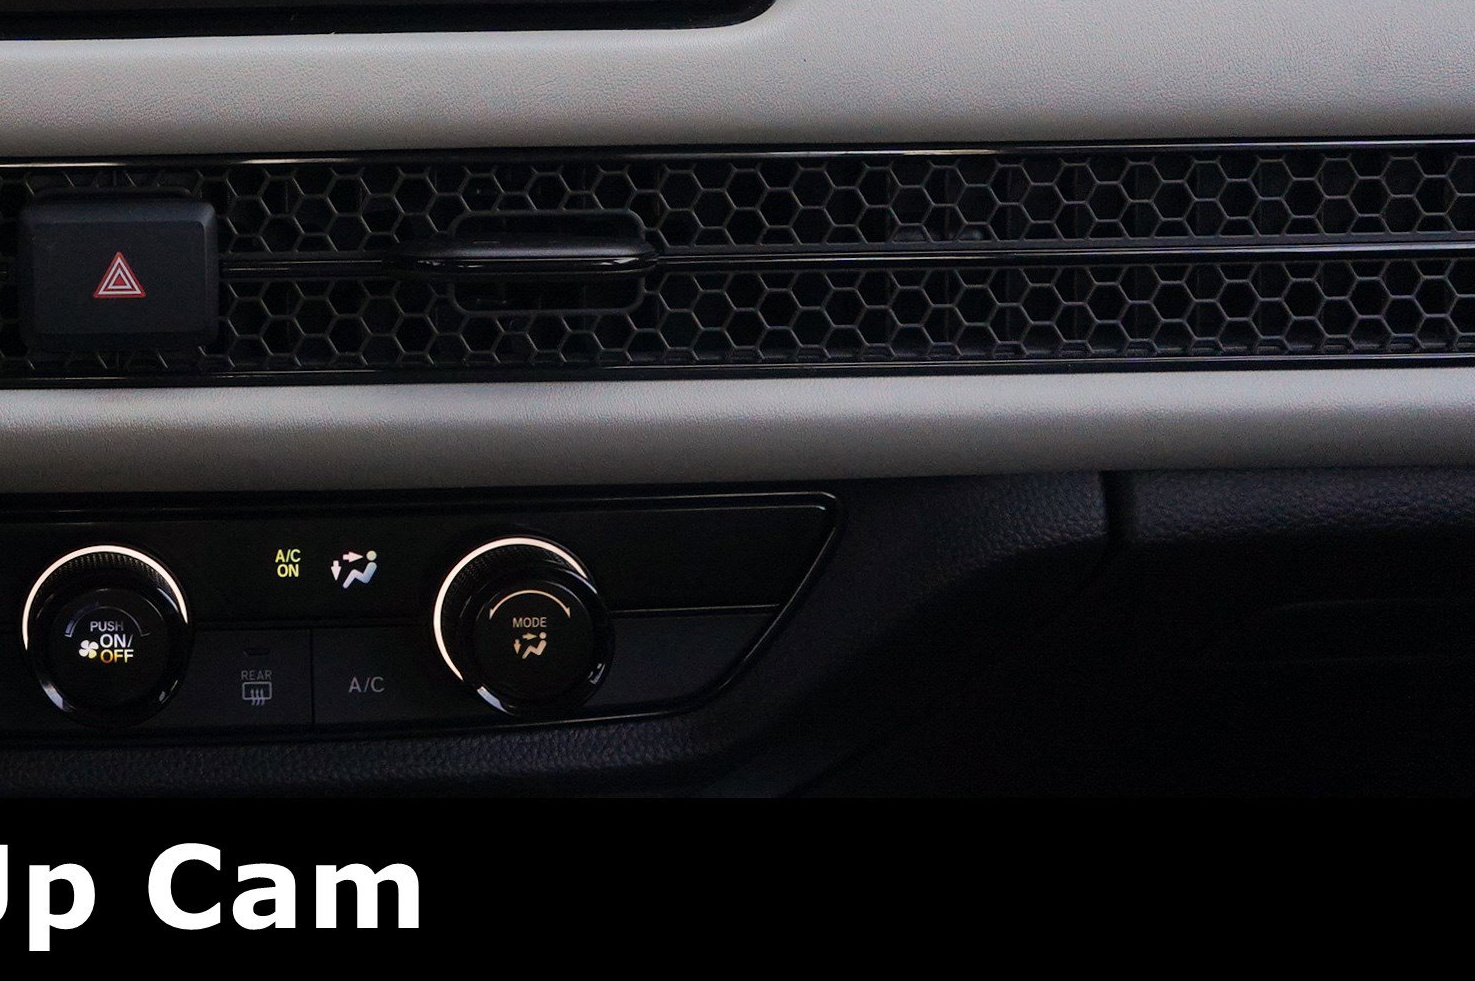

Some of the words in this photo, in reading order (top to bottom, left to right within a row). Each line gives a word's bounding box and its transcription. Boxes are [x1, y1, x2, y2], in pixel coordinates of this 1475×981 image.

[275, 549, 301, 563] A/C
[276, 564, 300, 578] ON
[90, 621, 124, 632] PUSH
[512, 617, 547, 628] MODE
[100, 649, 134, 664] OFF
[241, 670, 273, 681] REAR
[348, 676, 385, 693] A/C
